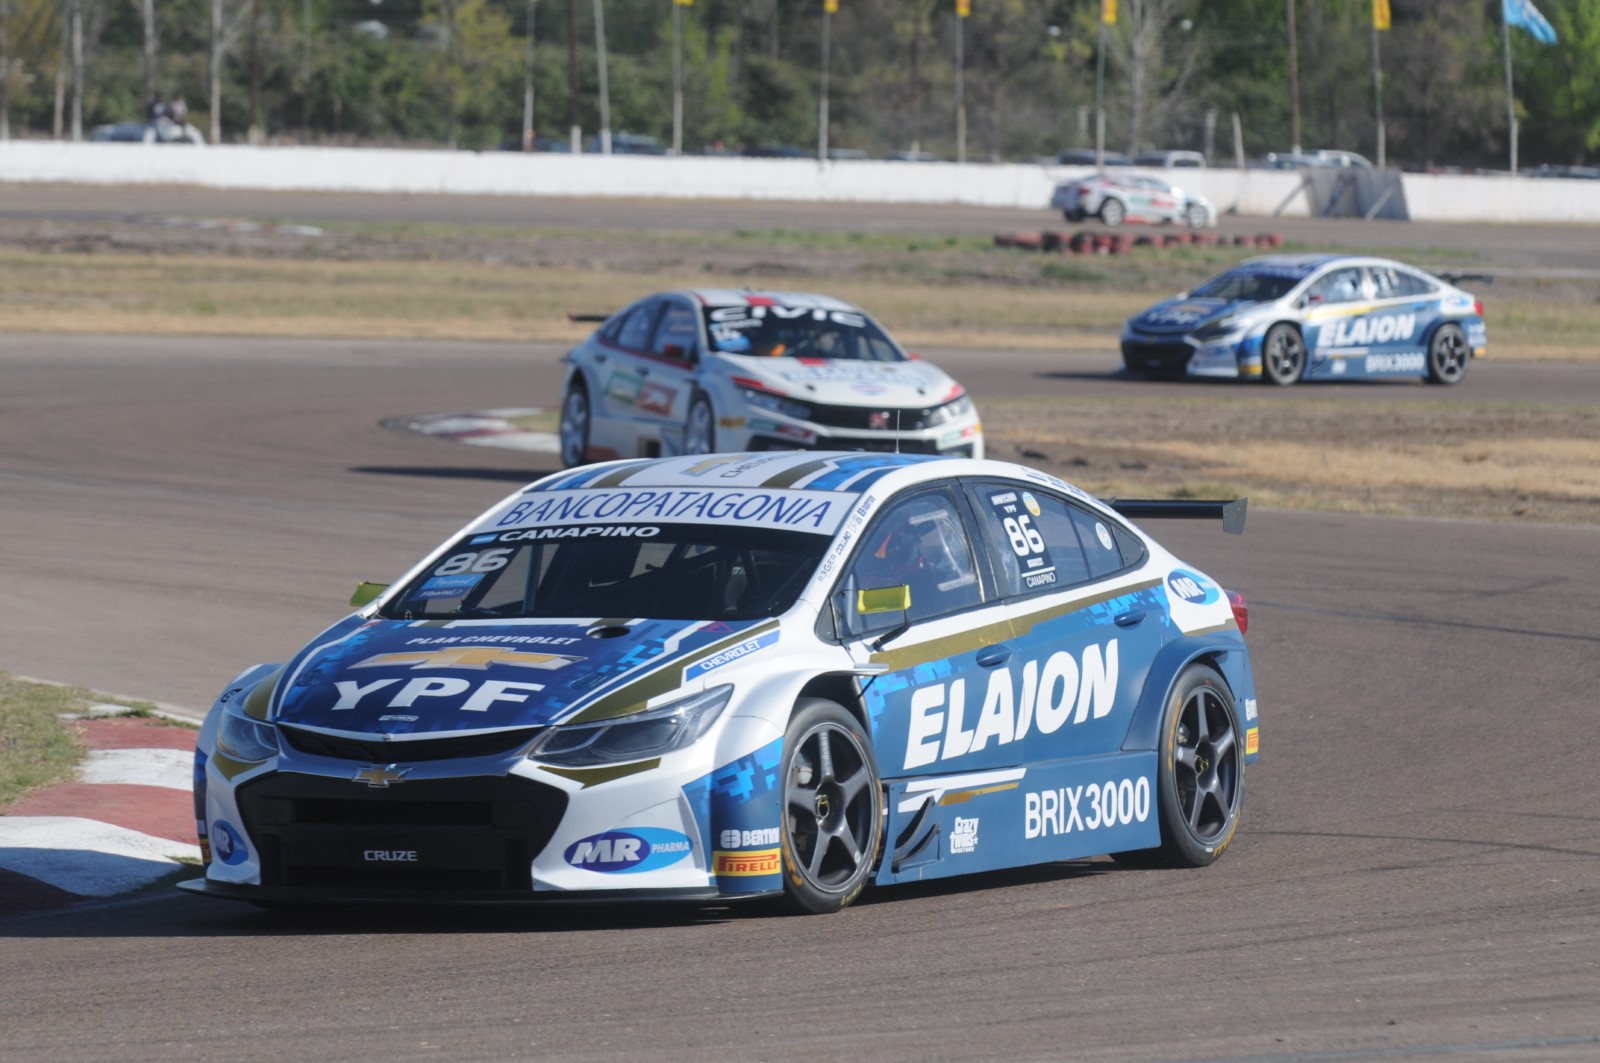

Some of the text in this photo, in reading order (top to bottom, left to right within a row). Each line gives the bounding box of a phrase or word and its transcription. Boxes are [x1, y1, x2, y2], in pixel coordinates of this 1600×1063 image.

[1316, 313, 1416, 347] ELAION
[1365, 353, 1425, 373] BRIX3000
[1003, 504, 1017, 513] YPF
[499, 526, 661, 542] CANAPINO
[1003, 514, 1045, 557] 86
[434, 548, 516, 577] 86
[1026, 572, 1056, 588] CANAPINO
[1170, 576, 1206, 600] MR
[405, 635, 582, 645] PLAN CHEVROLET
[700, 639, 762, 670] CHEVROLET
[331, 676, 546, 712] YPF
[903, 638, 1119, 770] ELAION
[1025, 776, 1151, 840] BRIX3000
[742, 827, 780, 847] BERTINI
[363, 850, 419, 861] CRUZE
[570, 838, 690, 864] MR PHARMA
[717, 853, 778, 872] PIRELLI
